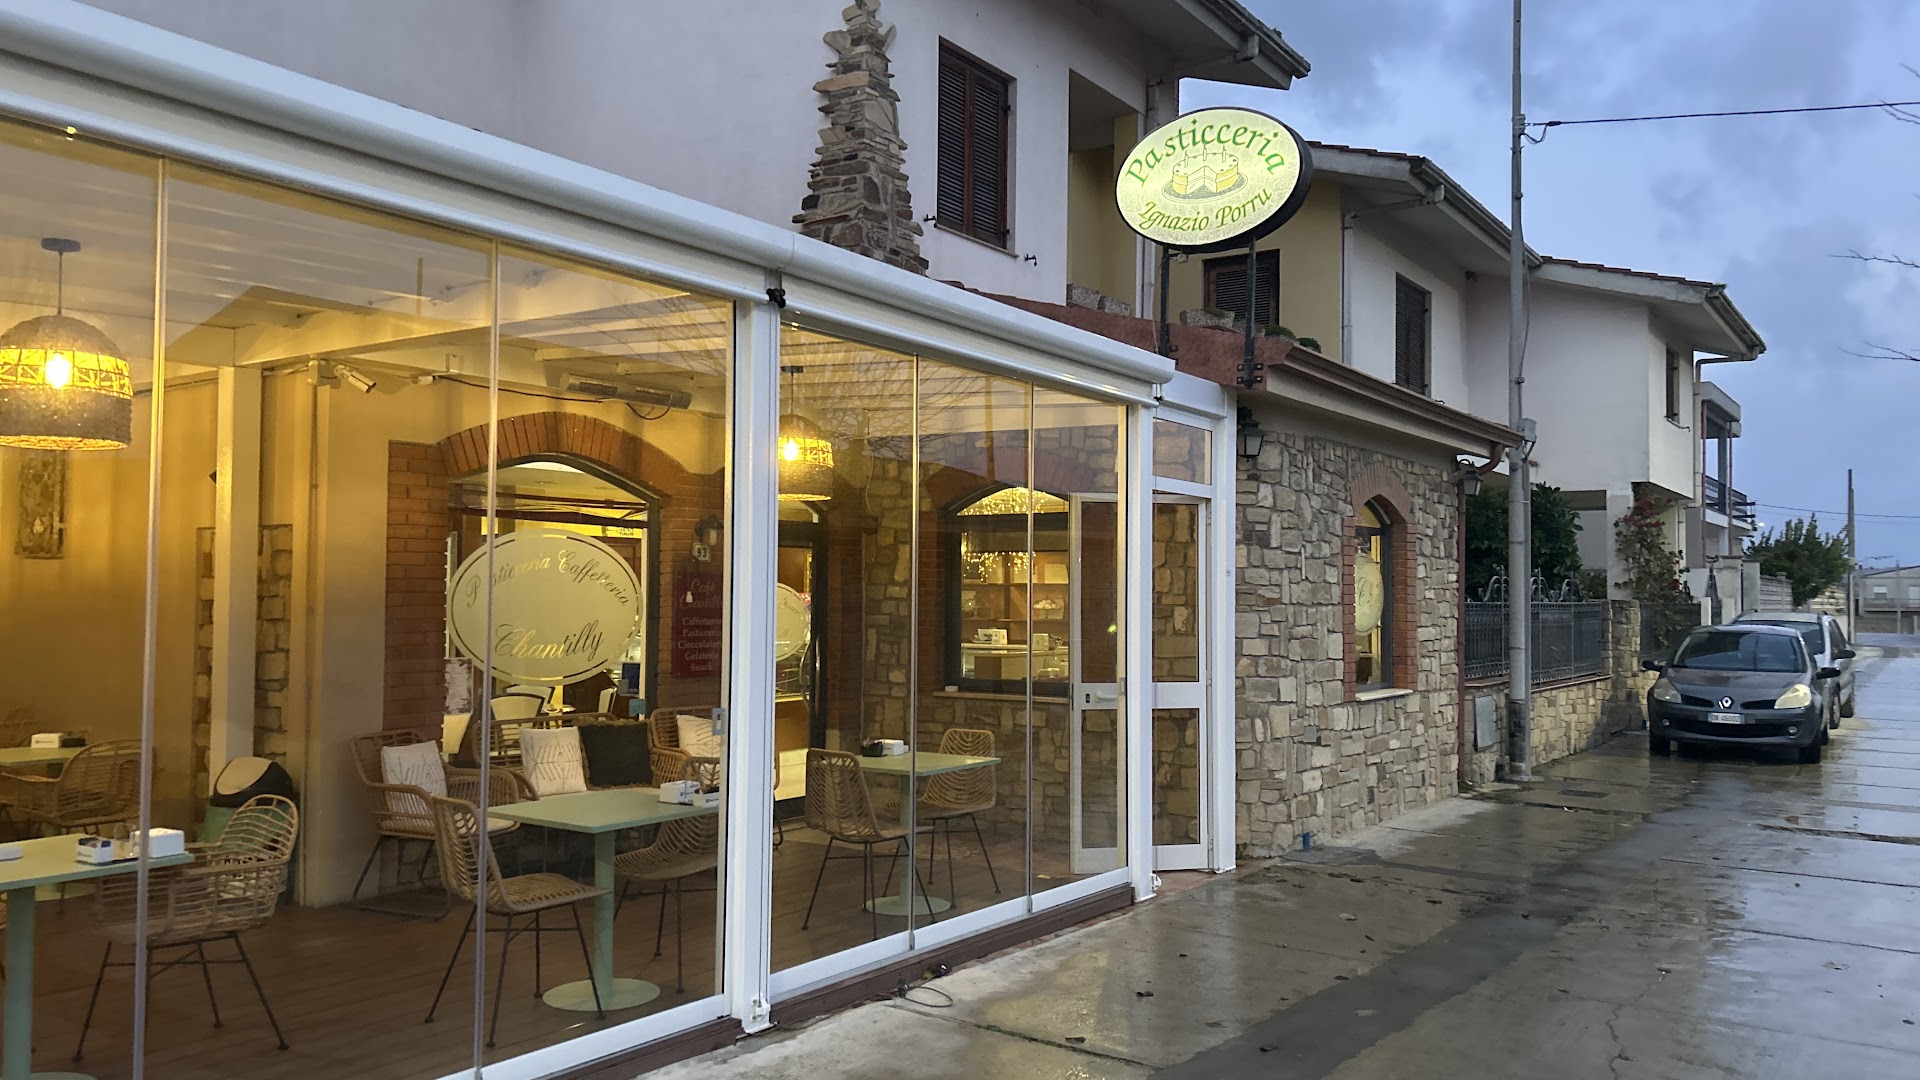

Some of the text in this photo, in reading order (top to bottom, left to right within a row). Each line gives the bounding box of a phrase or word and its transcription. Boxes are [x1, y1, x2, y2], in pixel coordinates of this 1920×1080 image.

[1126, 118, 1285, 188] Pasticceria
[1138, 188, 1273, 232] Ignazio Porru
[697, 547, 707, 558] 93
[466, 553, 551, 608] Psticceria
[494, 618, 605, 662] Chantilly
[677, 640, 721, 649] Cioccolateri
[684, 651, 719, 661] Gelateria
[690, 662, 713, 672] Snack
